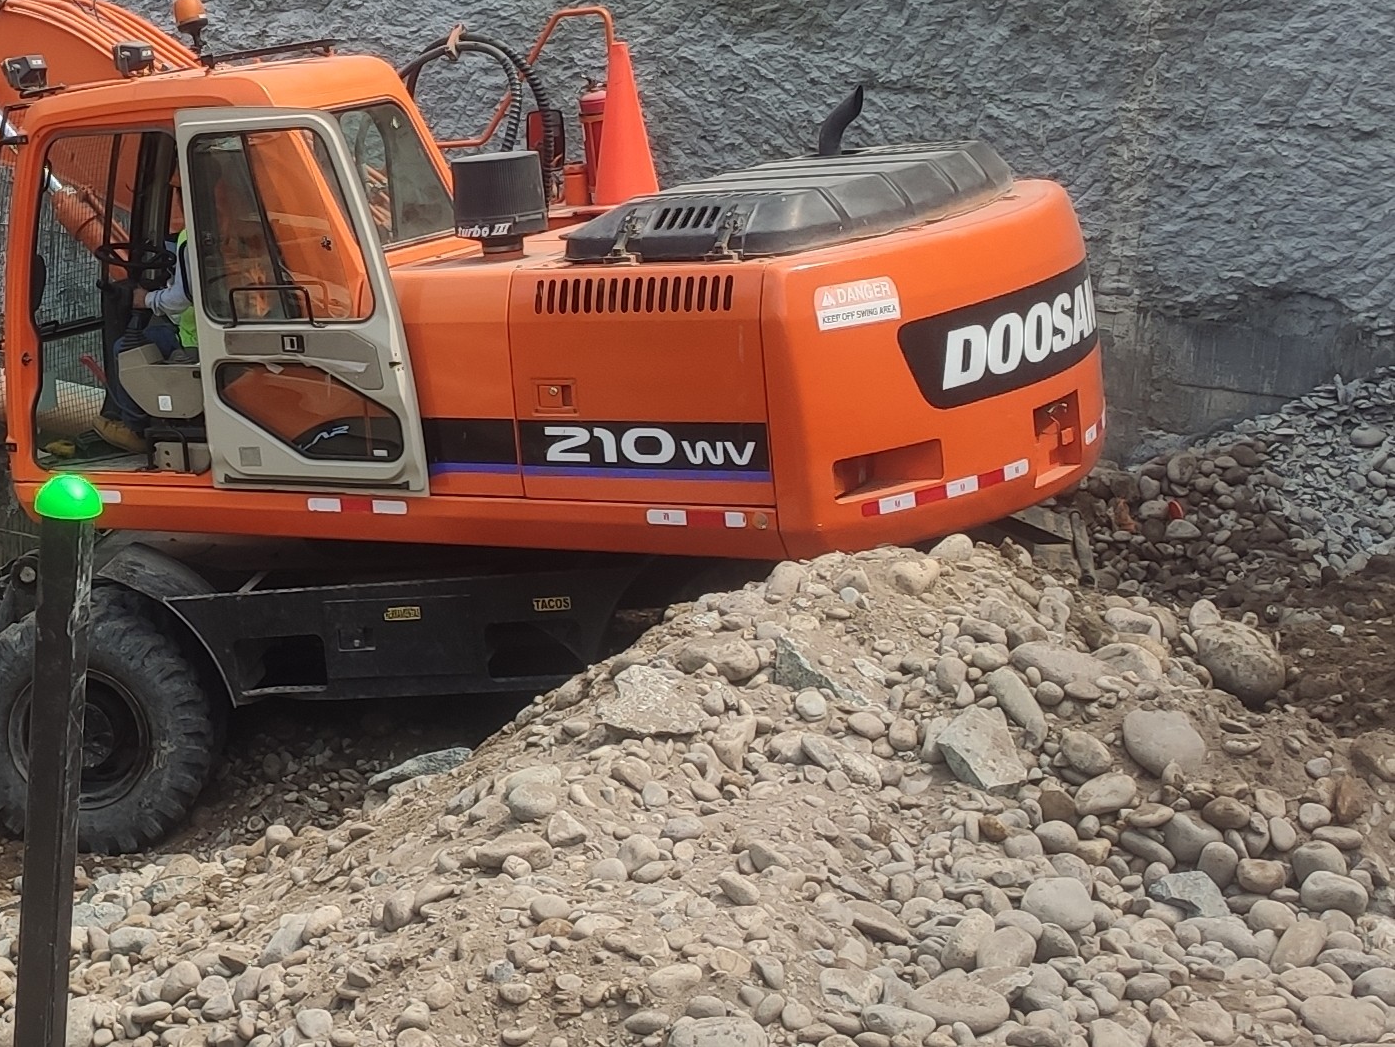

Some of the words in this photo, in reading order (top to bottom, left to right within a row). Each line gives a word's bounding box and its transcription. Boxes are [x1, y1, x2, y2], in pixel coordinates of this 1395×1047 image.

[458, 224, 489, 237] turbo
[491, 223, 512, 236] III
[836, 281, 891, 304] DANGER
[822, 313, 841, 325] KEEP
[841, 311, 855, 321] OFF
[856, 307, 878, 319] SWING
[879, 303, 896, 314] AREA
[543, 426, 676, 464] 210
[534, 597, 570, 610] TACOS
